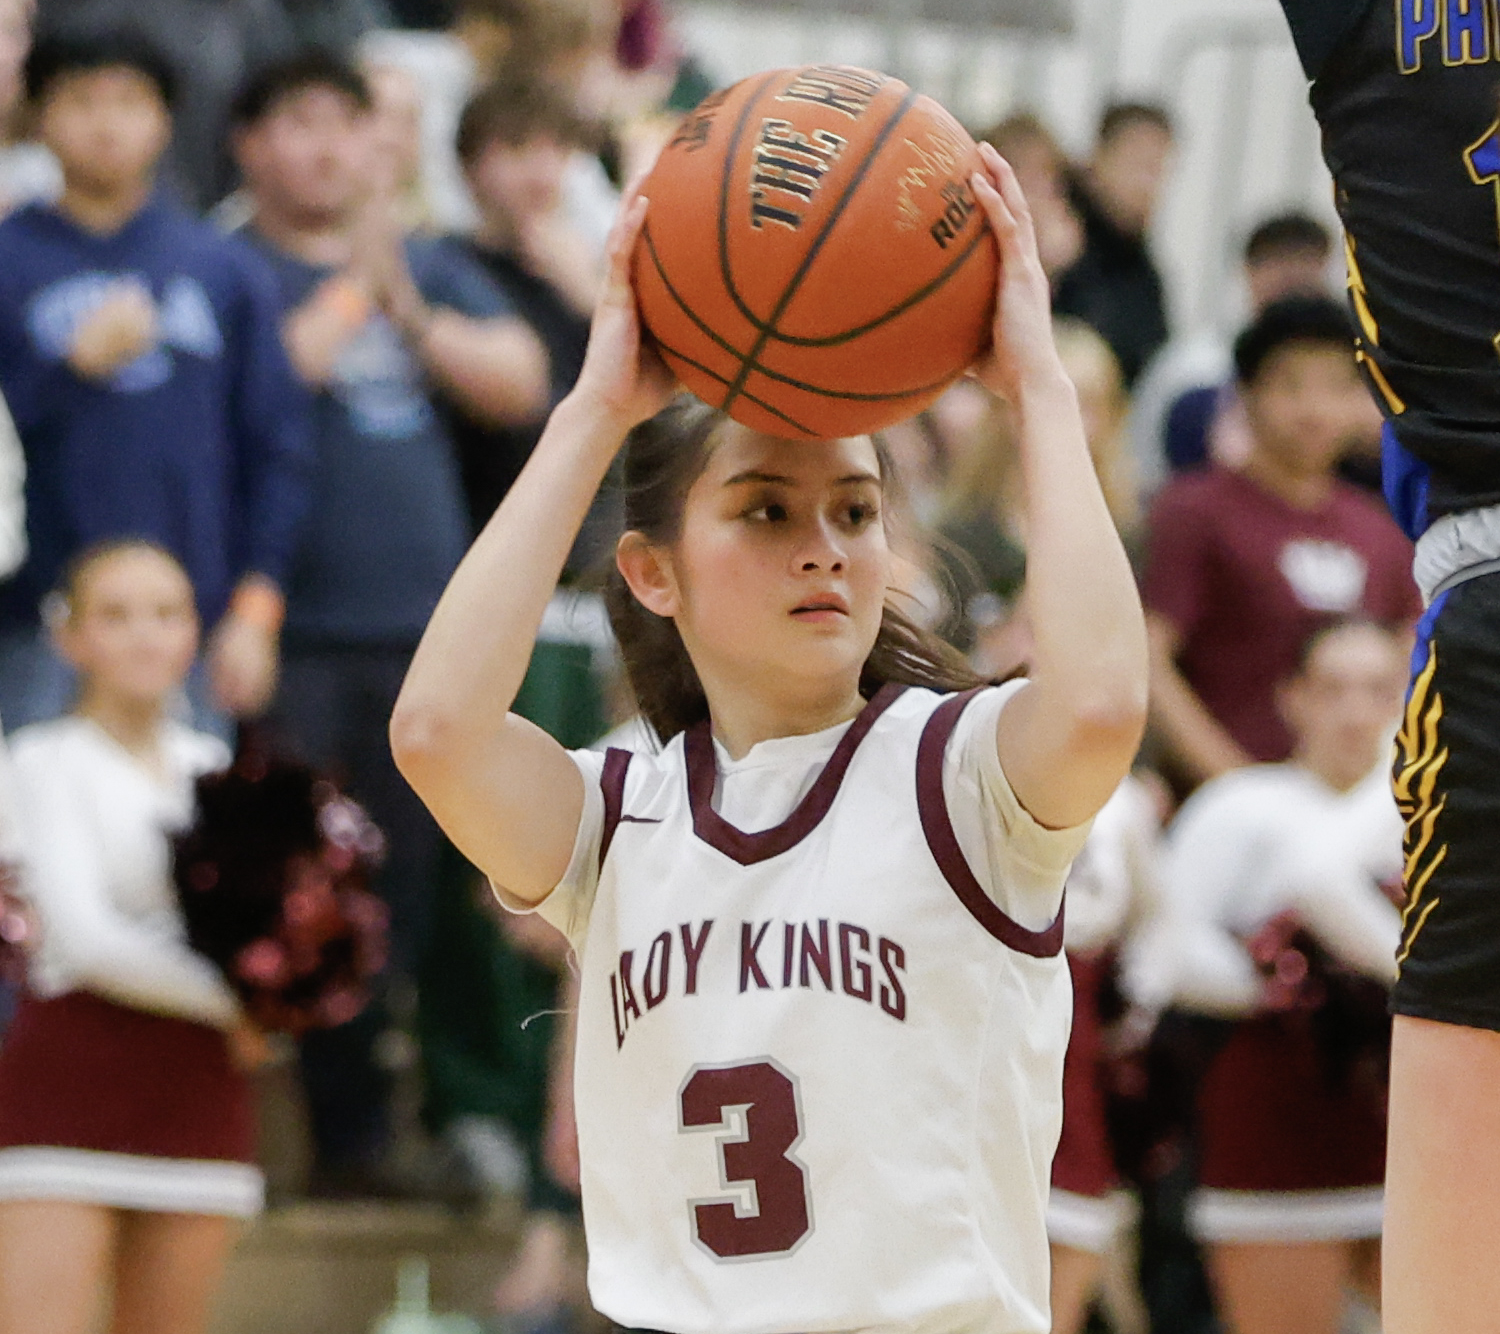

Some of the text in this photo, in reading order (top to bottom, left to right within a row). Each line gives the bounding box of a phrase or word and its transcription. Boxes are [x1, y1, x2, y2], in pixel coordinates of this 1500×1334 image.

[751, 117, 848, 232] THE
[610, 918, 908, 1053] LADY KINGS
[676, 1054, 815, 1266] 3
